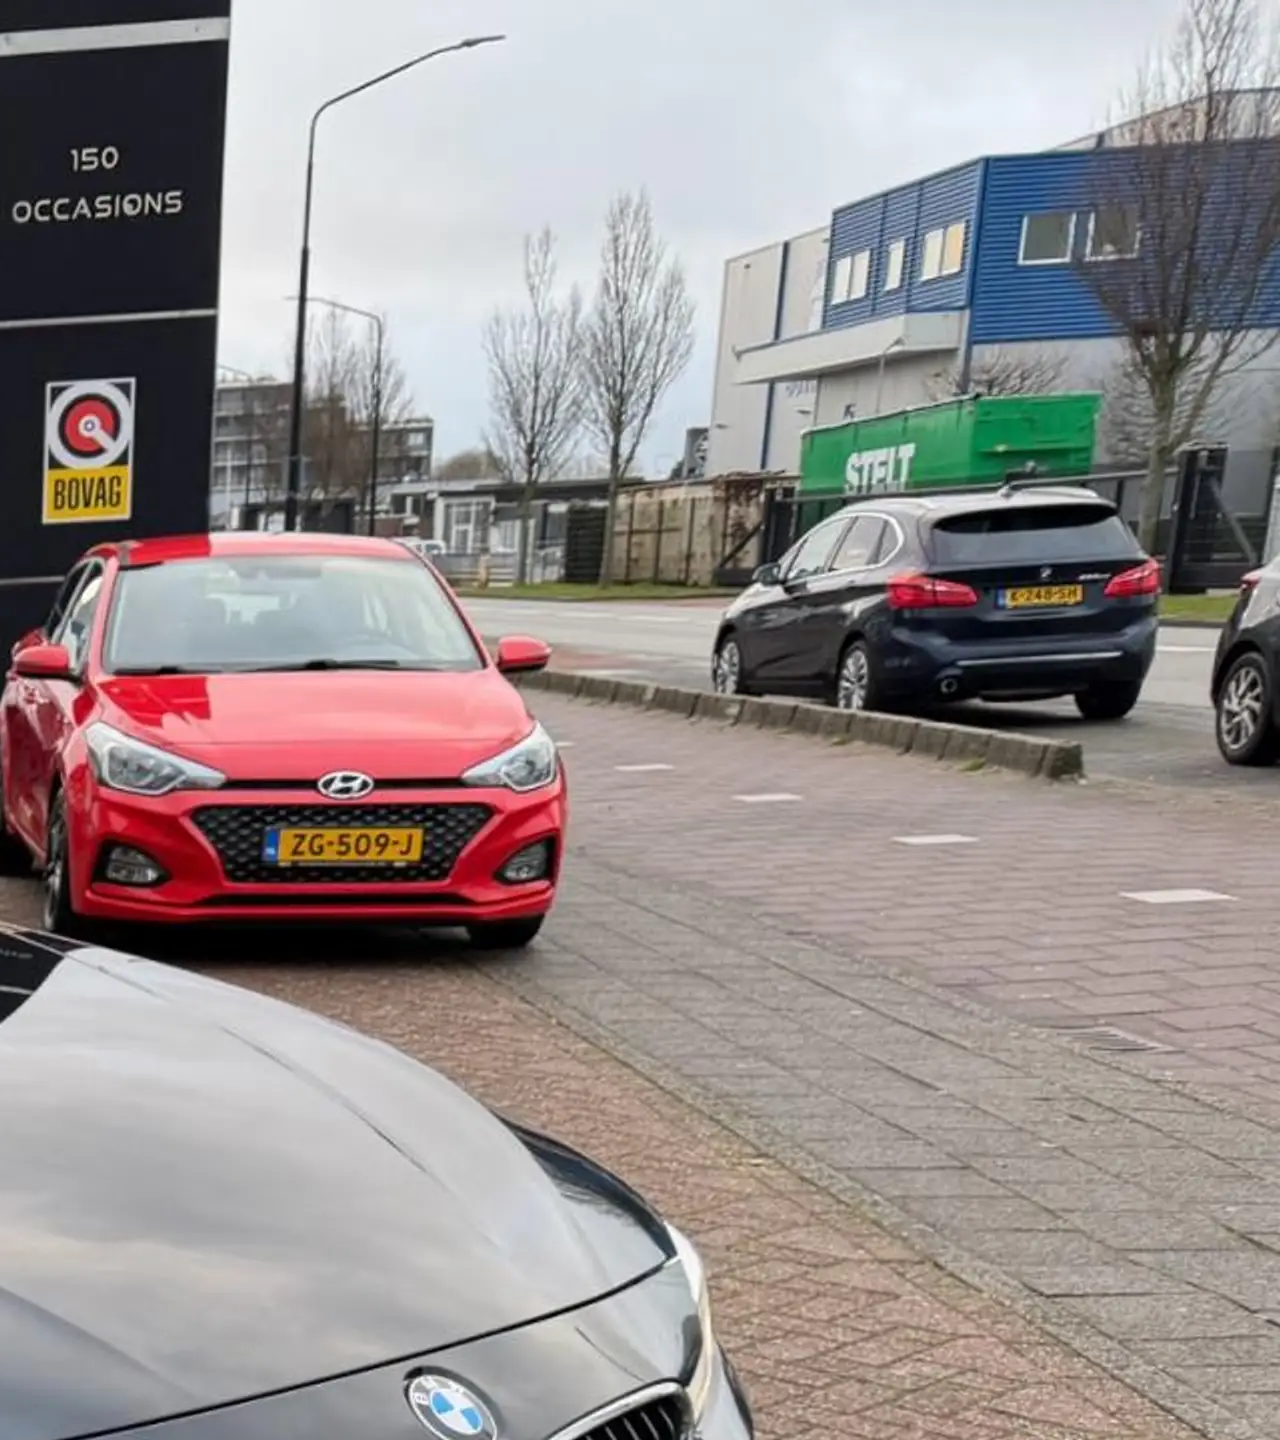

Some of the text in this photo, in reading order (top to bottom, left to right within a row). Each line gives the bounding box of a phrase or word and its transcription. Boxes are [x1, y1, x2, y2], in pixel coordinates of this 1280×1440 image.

[69, 145, 120, 173] 150
[11, 189, 184, 224] OCCASIONS
[844, 442, 917, 496] STELT
[53, 475, 123, 511] BOVAG
[291, 832, 414, 857] ZG-509-J
